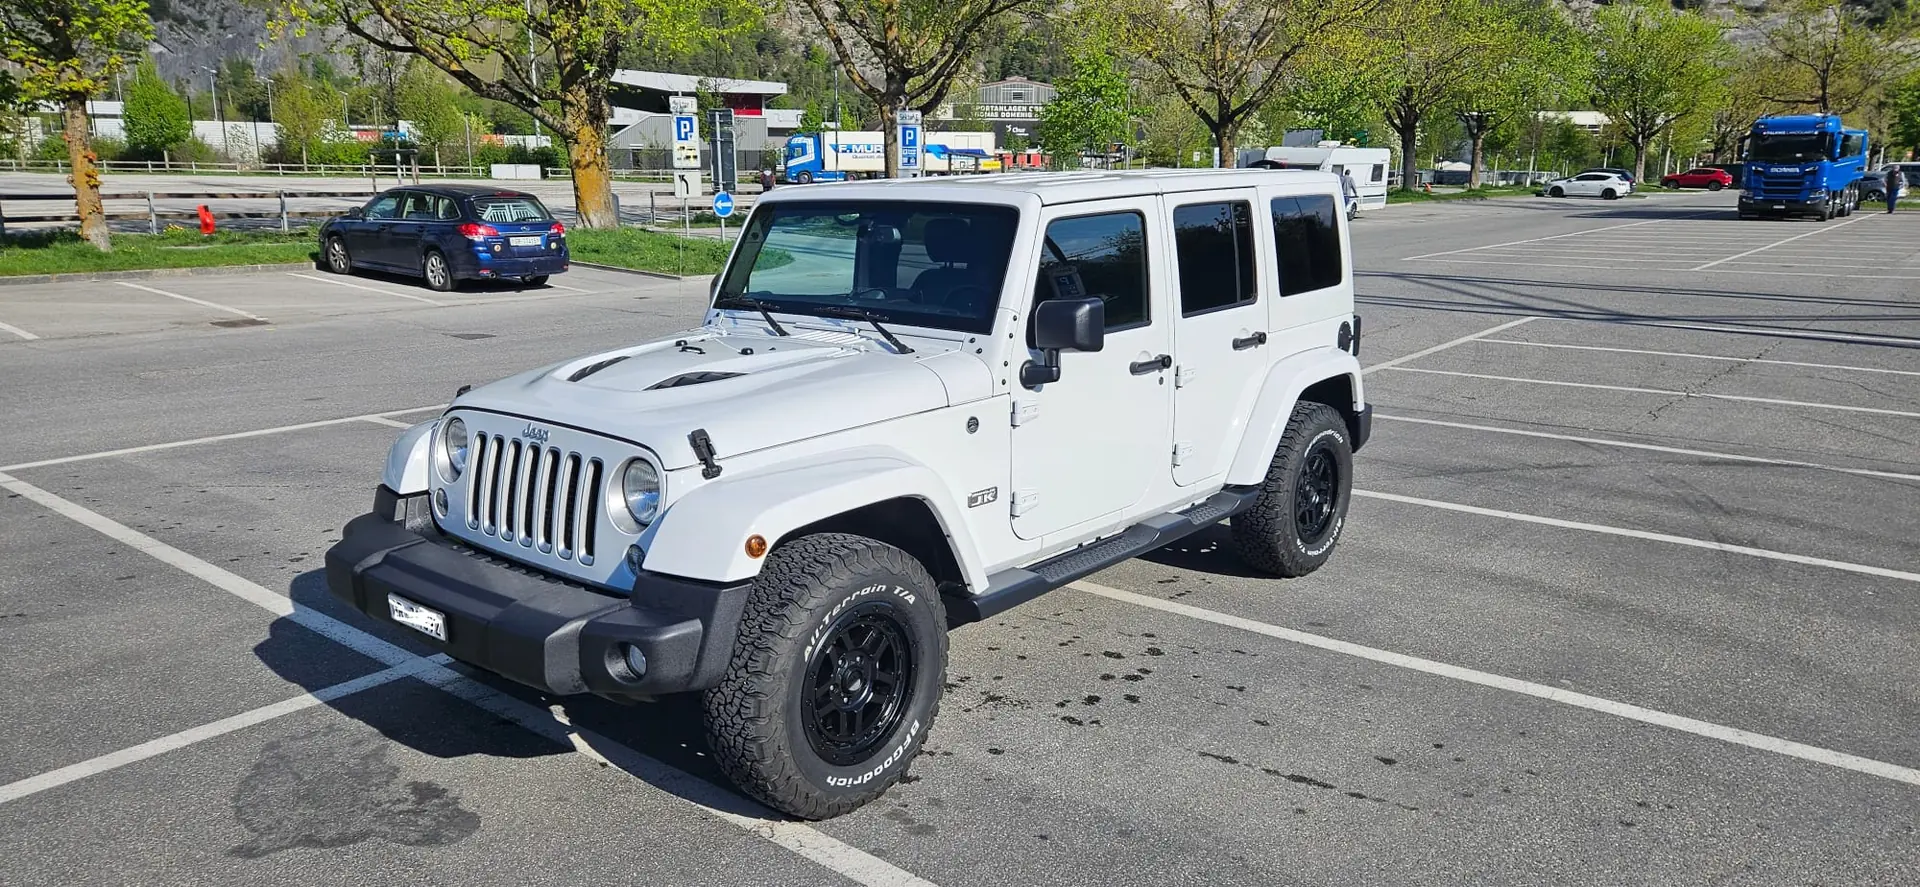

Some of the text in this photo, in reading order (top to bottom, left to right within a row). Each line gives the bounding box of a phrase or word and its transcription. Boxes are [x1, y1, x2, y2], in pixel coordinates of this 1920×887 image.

[680, 120, 690, 139] P
[905, 130, 914, 145] P
[522, 422, 550, 445] Jeep
[893, 585, 916, 605] T/A
[826, 719, 920, 788] BFGoodrich
